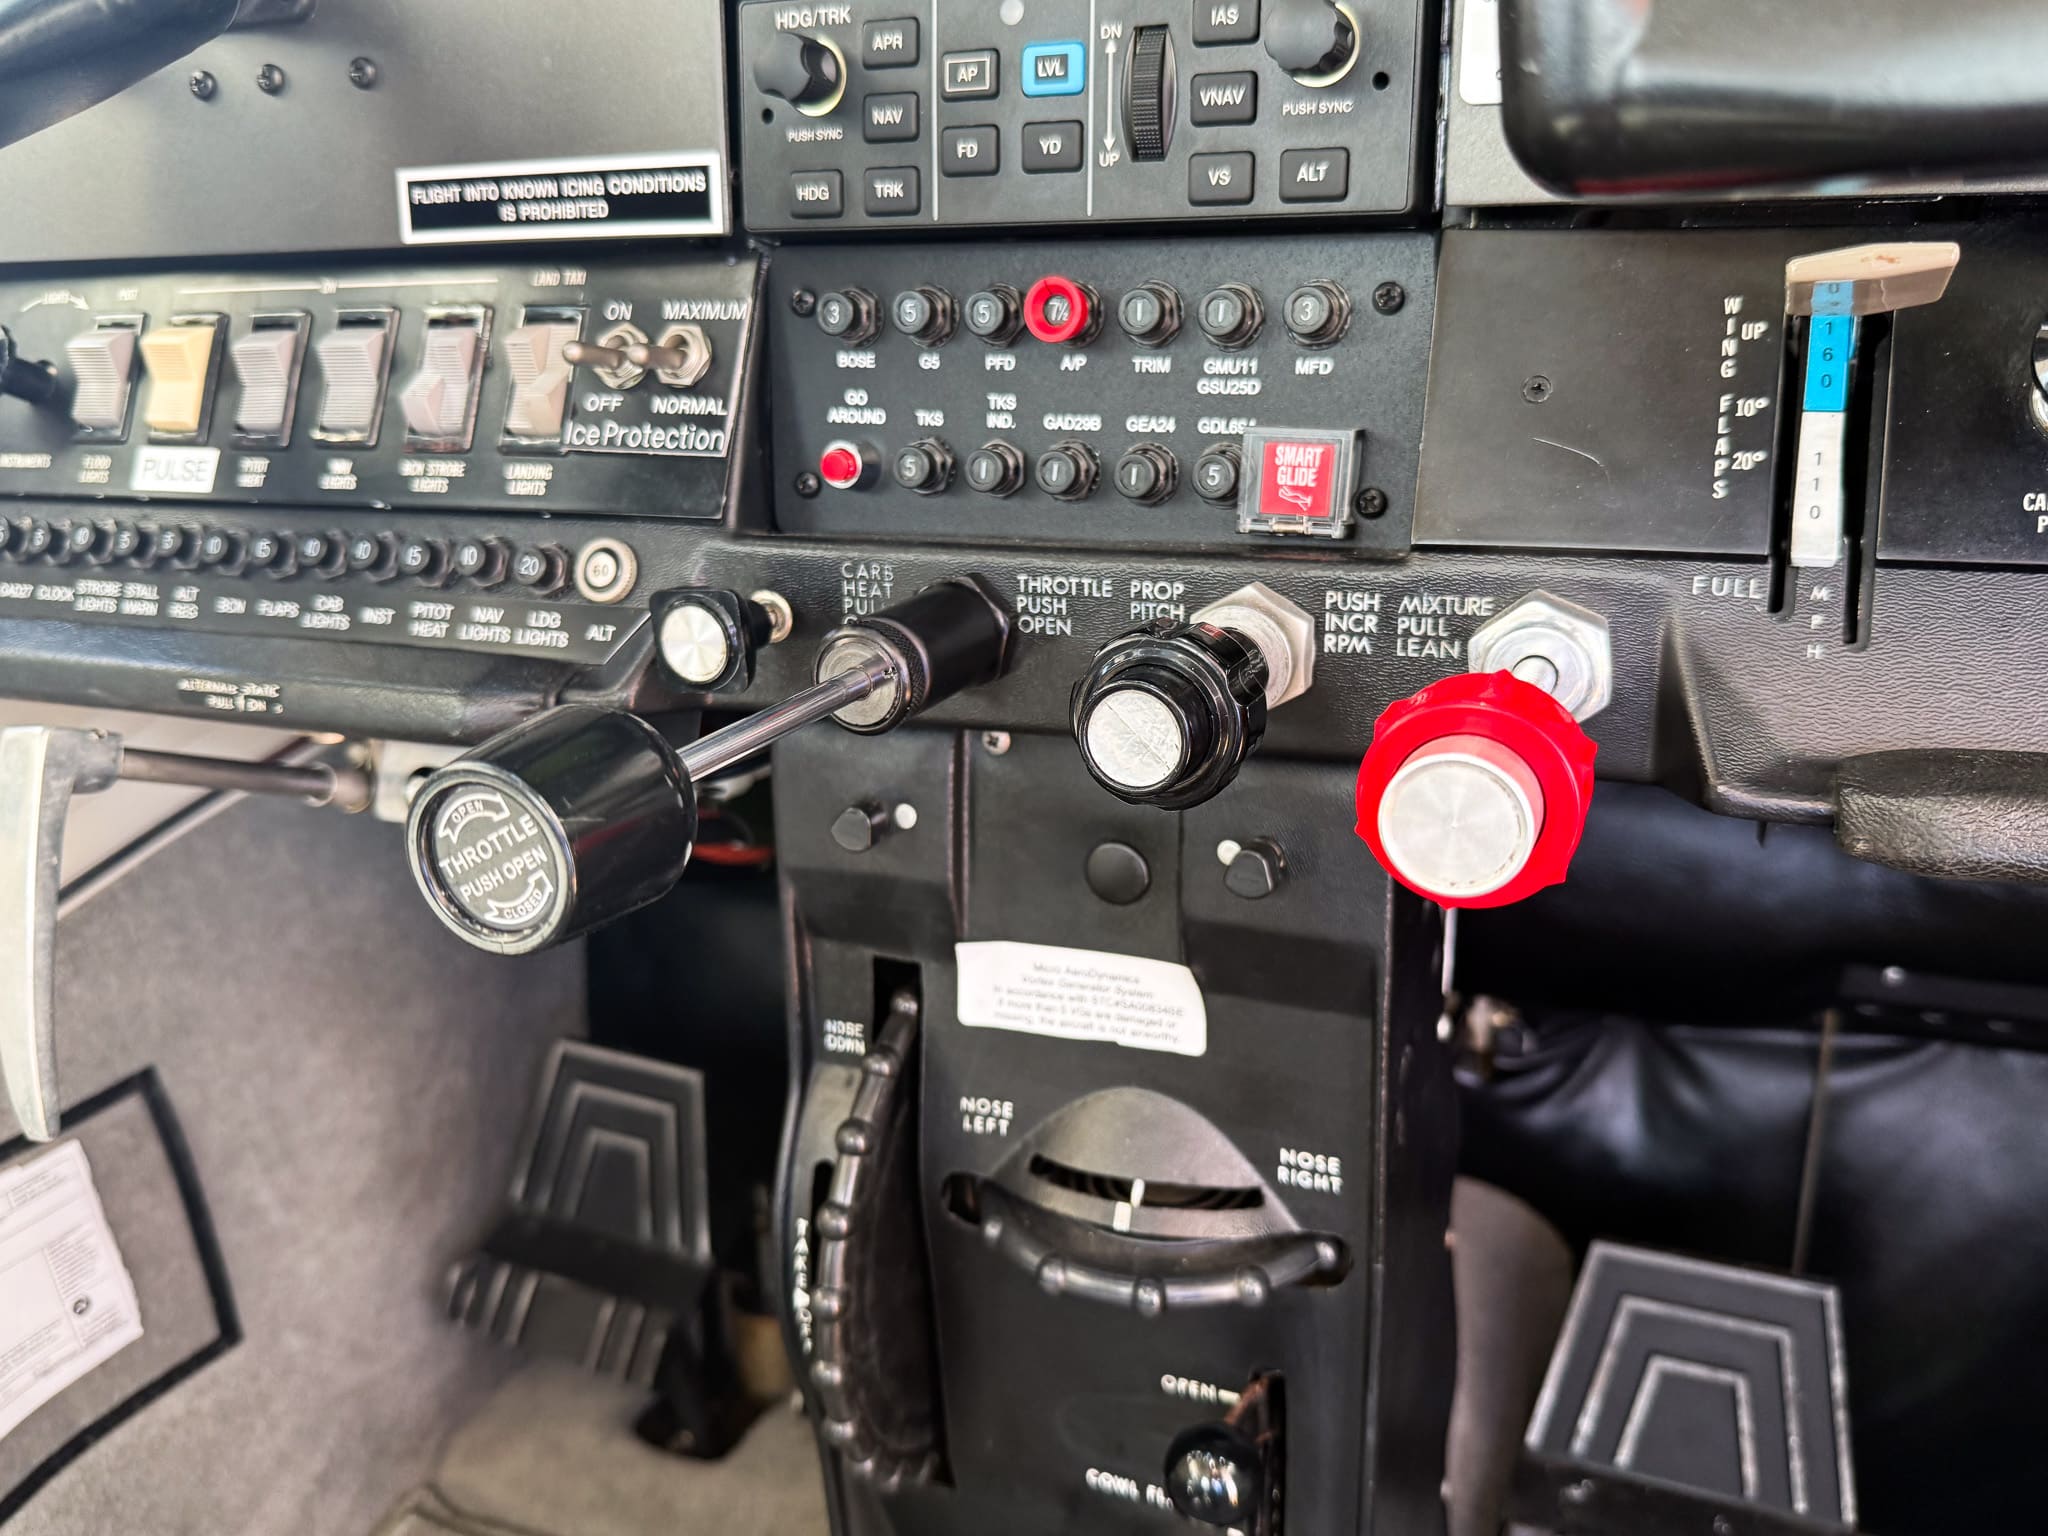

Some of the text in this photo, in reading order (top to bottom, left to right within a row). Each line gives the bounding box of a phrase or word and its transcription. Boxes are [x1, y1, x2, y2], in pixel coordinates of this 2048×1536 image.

[775, 8, 851, 30] HDG/TRK
[1211, 8, 1239, 27] IAS
[1100, 22, 1122, 40] DN
[873, 33, 903, 51] APR
[957, 62, 978, 83] AP
[1037, 57, 1066, 78] LVL
[1200, 88, 1246, 107] VNAV
[872, 106, 903, 126] NAV
[1283, 101, 1354, 117] PUSH SYNC
[787, 127, 843, 142] PUSH SYNC
[957, 139, 978, 158] FD
[1039, 136, 1062, 155] YD
[1098, 151, 1120, 168] UP
[1208, 166, 1232, 186] VS
[1297, 161, 1328, 183] ALT
[411, 170, 706, 205] FLIGHT INTO KNOWN ICING CONDITIONS
[797, 184, 830, 201] HDG
[874, 181, 904, 198] TRK
[500, 200, 609, 222] IS PROHIBITED
[605, 303, 633, 321] ON
[662, 301, 748, 321] MAXIMUM
[827, 306, 840, 324] 3
[903, 304, 917, 323] 5
[977, 304, 991, 323] 5
[1300, 301, 1313, 321] 3
[1741, 322, 1769, 341] UP
[836, 352, 876, 368] BOSE
[918, 353, 941, 370] G5
[985, 353, 1016, 371] PFD
[1132, 356, 1172, 374] TRIM
[1203, 358, 1258, 375] GMU11
[1295, 357, 1334, 375] MFD
[1196, 378, 1262, 395] GSU25D
[584, 393, 624, 412] OFF
[652, 396, 728, 416] NORMAL
[844, 389, 868, 406] GO
[987, 393, 1017, 411] TKS
[827, 408, 886, 425] AROUND
[915, 410, 944, 427] TKS
[986, 412, 1016, 429] IND.
[1043, 414, 1102, 432] GAD29B
[1125, 417, 1176, 433] GEA24
[563, 421, 725, 449] Ice Protection
[1275, 446, 1323, 466] SMART
[143, 459, 209, 483] PULSE
[504, 463, 553, 480] LANDING
[903, 459, 916, 477] 5
[1207, 466, 1221, 485] 5
[1277, 467, 1317, 486] GLIDE
[505, 480, 546, 495] LIGHTS
[2023, 493, 2048, 512] CA
[463, 545, 477, 565] 10
[519, 556, 539, 576] 20
[841, 563, 894, 581] CARB
[843, 580, 894, 599] HEAT
[1017, 574, 1113, 597] THROTTLE
[1130, 580, 1185, 600] PROP
[1693, 577, 1763, 599] FULL
[409, 601, 454, 619] PITOT
[1017, 596, 1067, 615] PUSH
[1326, 591, 1382, 612] PUSH
[1398, 595, 1494, 616] MIXTURE
[471, 606, 504, 623] NAV
[526, 610, 561, 628] LDG
[1130, 603, 1185, 622] PITCH
[408, 620, 450, 638] HEAT
[1017, 615, 1072, 636] OPEN
[1326, 613, 1378, 633] INCR
[1397, 617, 1450, 637] PULL
[457, 624, 511, 643] LIGHTS
[513, 629, 569, 648] LIGHTS
[585, 624, 616, 642] ALT
[1324, 634, 1372, 655] RPM
[1397, 638, 1463, 660] LEAN
[451, 799, 485, 824] OPEN
[439, 813, 539, 879] THROTTLE
[460, 844, 549, 903] PUSH OPEN
[503, 888, 543, 919] CLOSED
[824, 1018, 864, 1037] NOSE
[824, 1035, 866, 1056] DOWN
[960, 1096, 1014, 1119] NOSE
[962, 1115, 1011, 1137] LEFT
[1279, 1147, 1343, 1176] NOSE
[1277, 1165, 1344, 1195] RIGHT
[1161, 1374, 1216, 1402] OPEN
[1086, 1468, 1140, 1501] COWL
